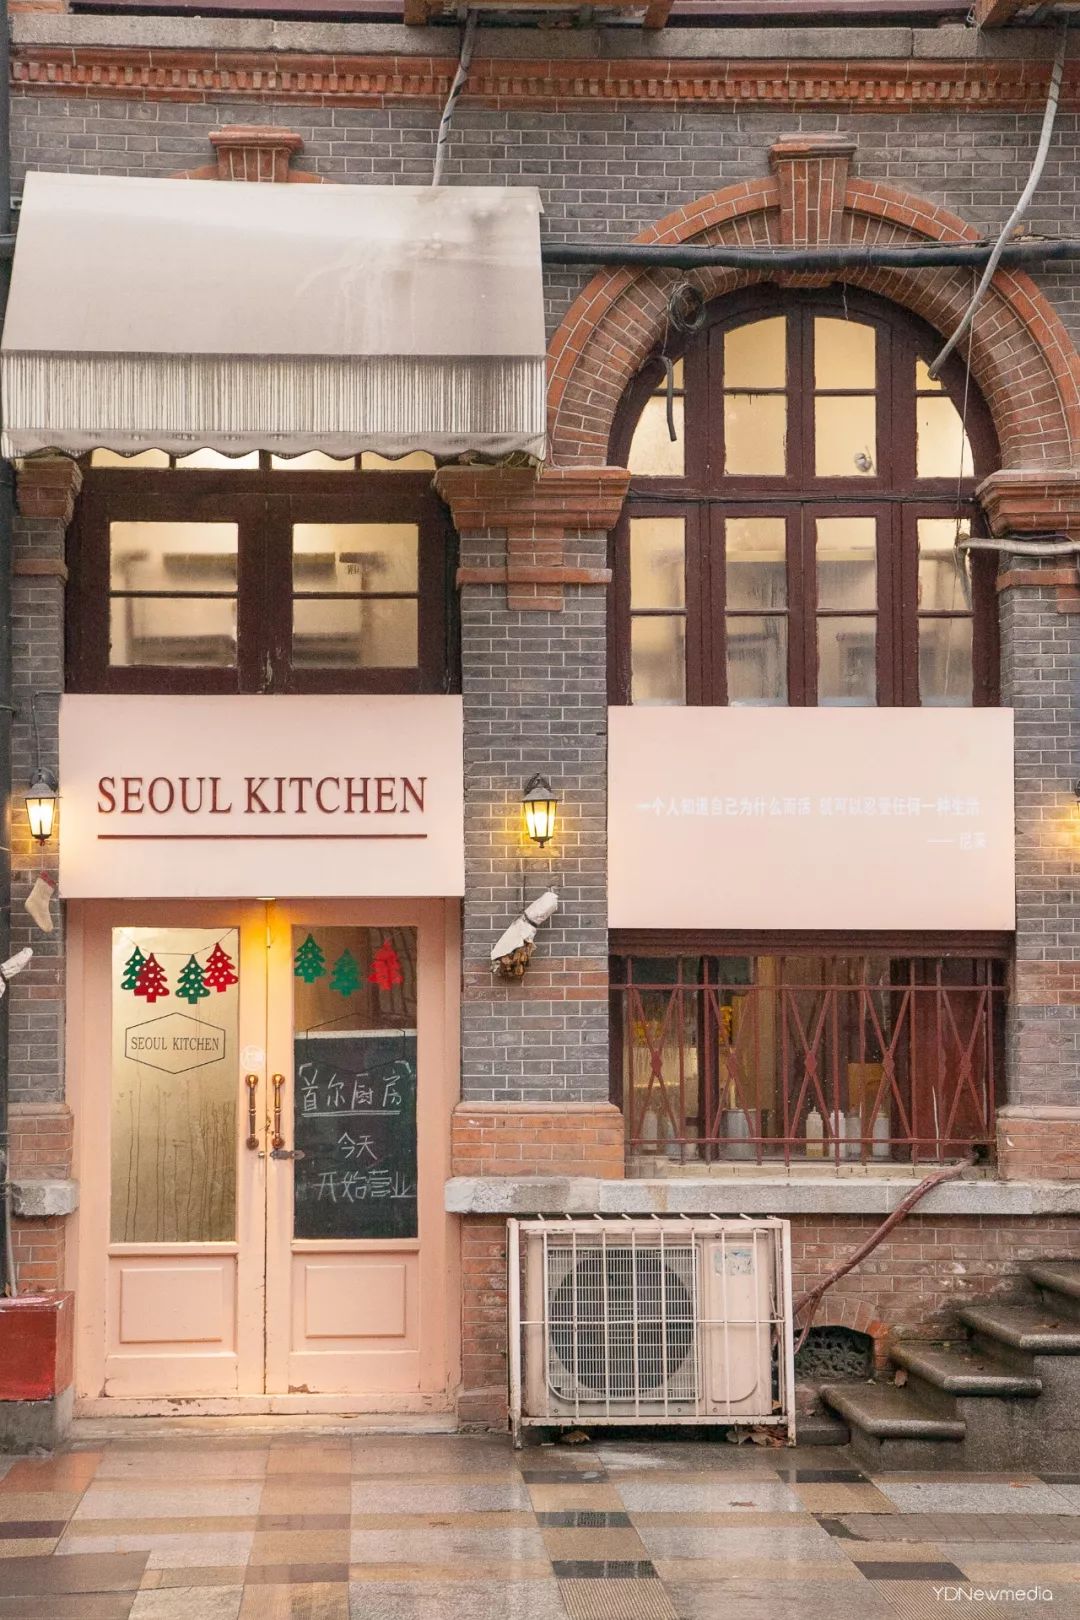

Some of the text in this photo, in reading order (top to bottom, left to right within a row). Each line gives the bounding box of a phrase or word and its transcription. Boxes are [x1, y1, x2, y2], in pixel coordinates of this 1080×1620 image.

[97, 776, 428, 814] SEOUL KITCHEN
[130, 1036, 220, 1052] SEOUL KITCHEN
[337, 1131, 378, 1161] 今天
[313, 1168, 416, 1203] 开始营业
